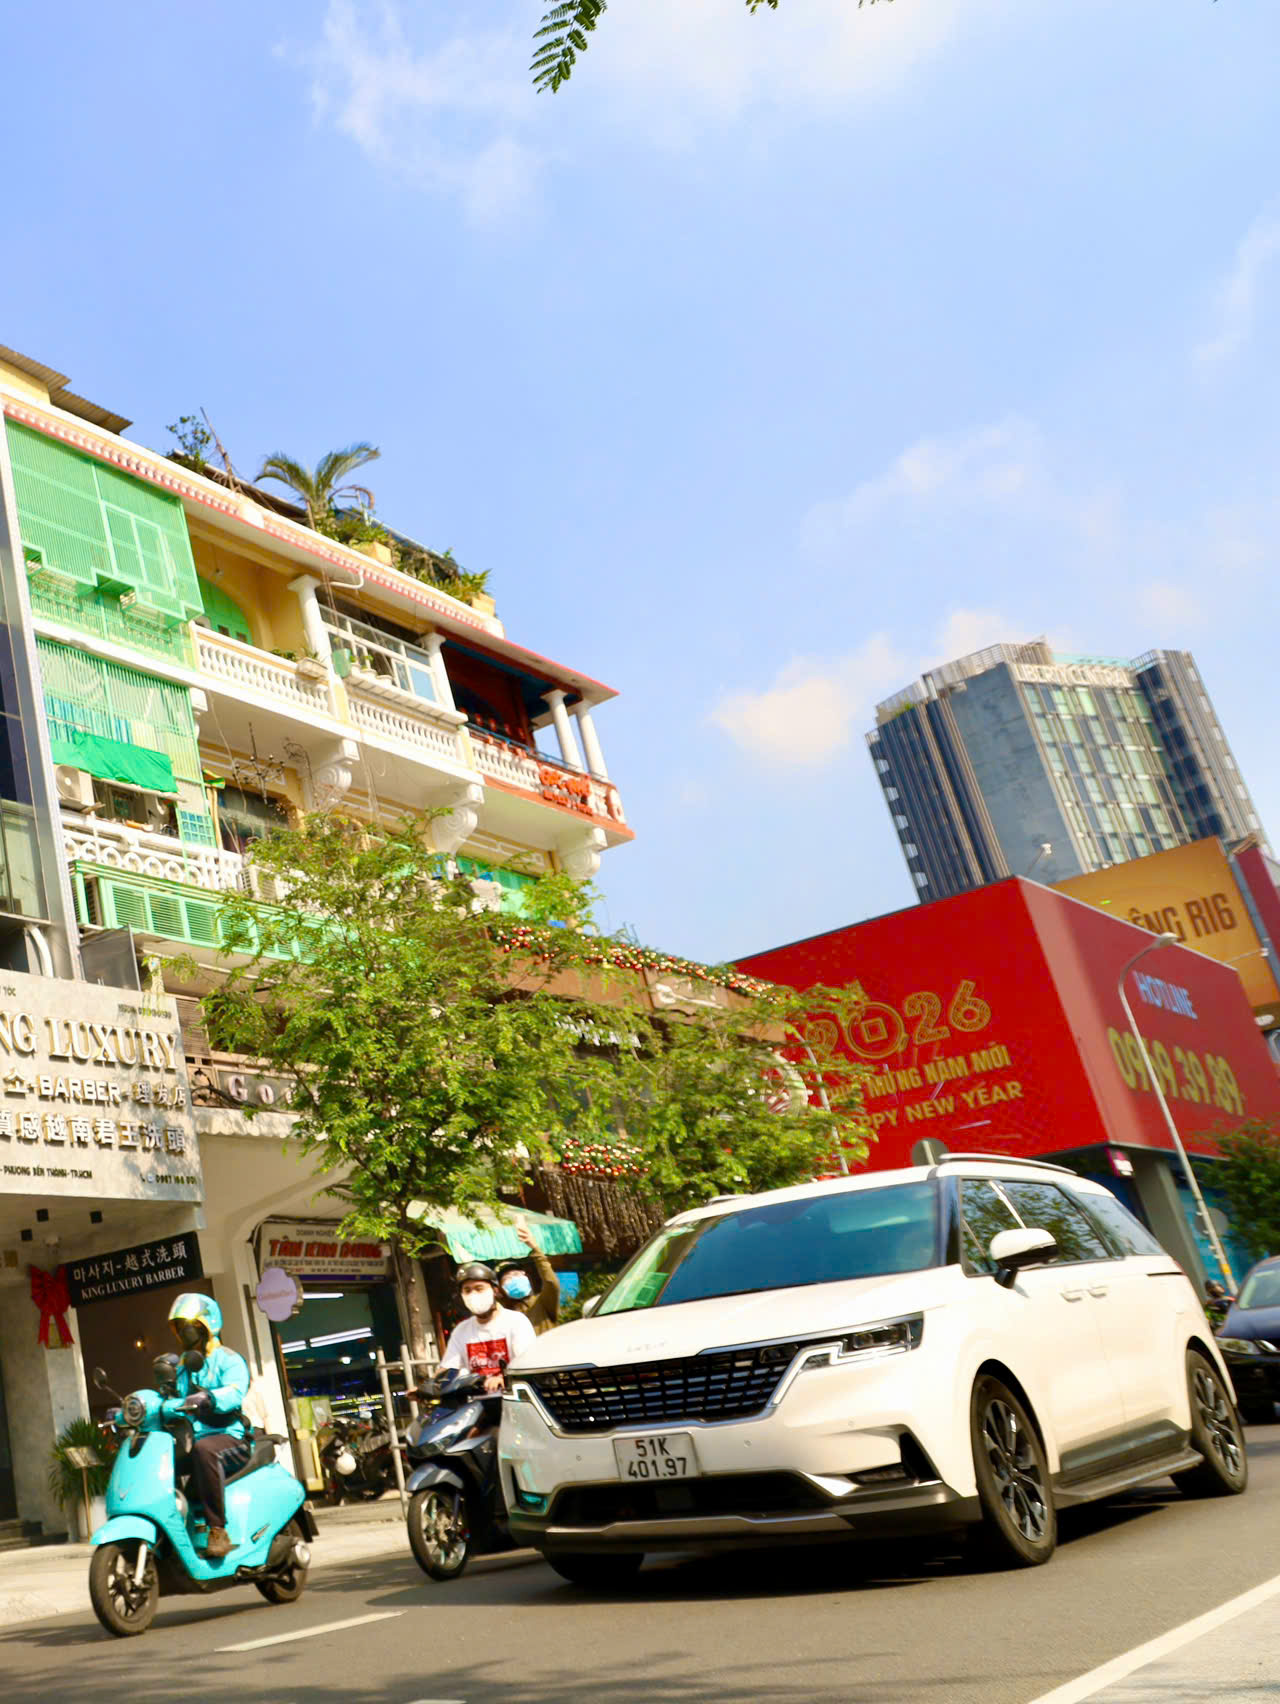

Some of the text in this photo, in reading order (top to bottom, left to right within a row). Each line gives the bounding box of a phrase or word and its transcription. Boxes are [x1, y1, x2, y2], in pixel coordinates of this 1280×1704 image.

[45, 1016, 180, 1070] LUXURY
[38, 1073, 122, 1104] BARBER
[906, 1096, 956, 1122] NEW
[962, 1080, 1024, 1111] YEAR
[73, 1260, 114, 1283] 마사지
[81, 1266, 185, 1300] KING LUXURY BARBER
[635, 1437, 671, 1457] 51K
[628, 1457, 687, 1479] 401.97
